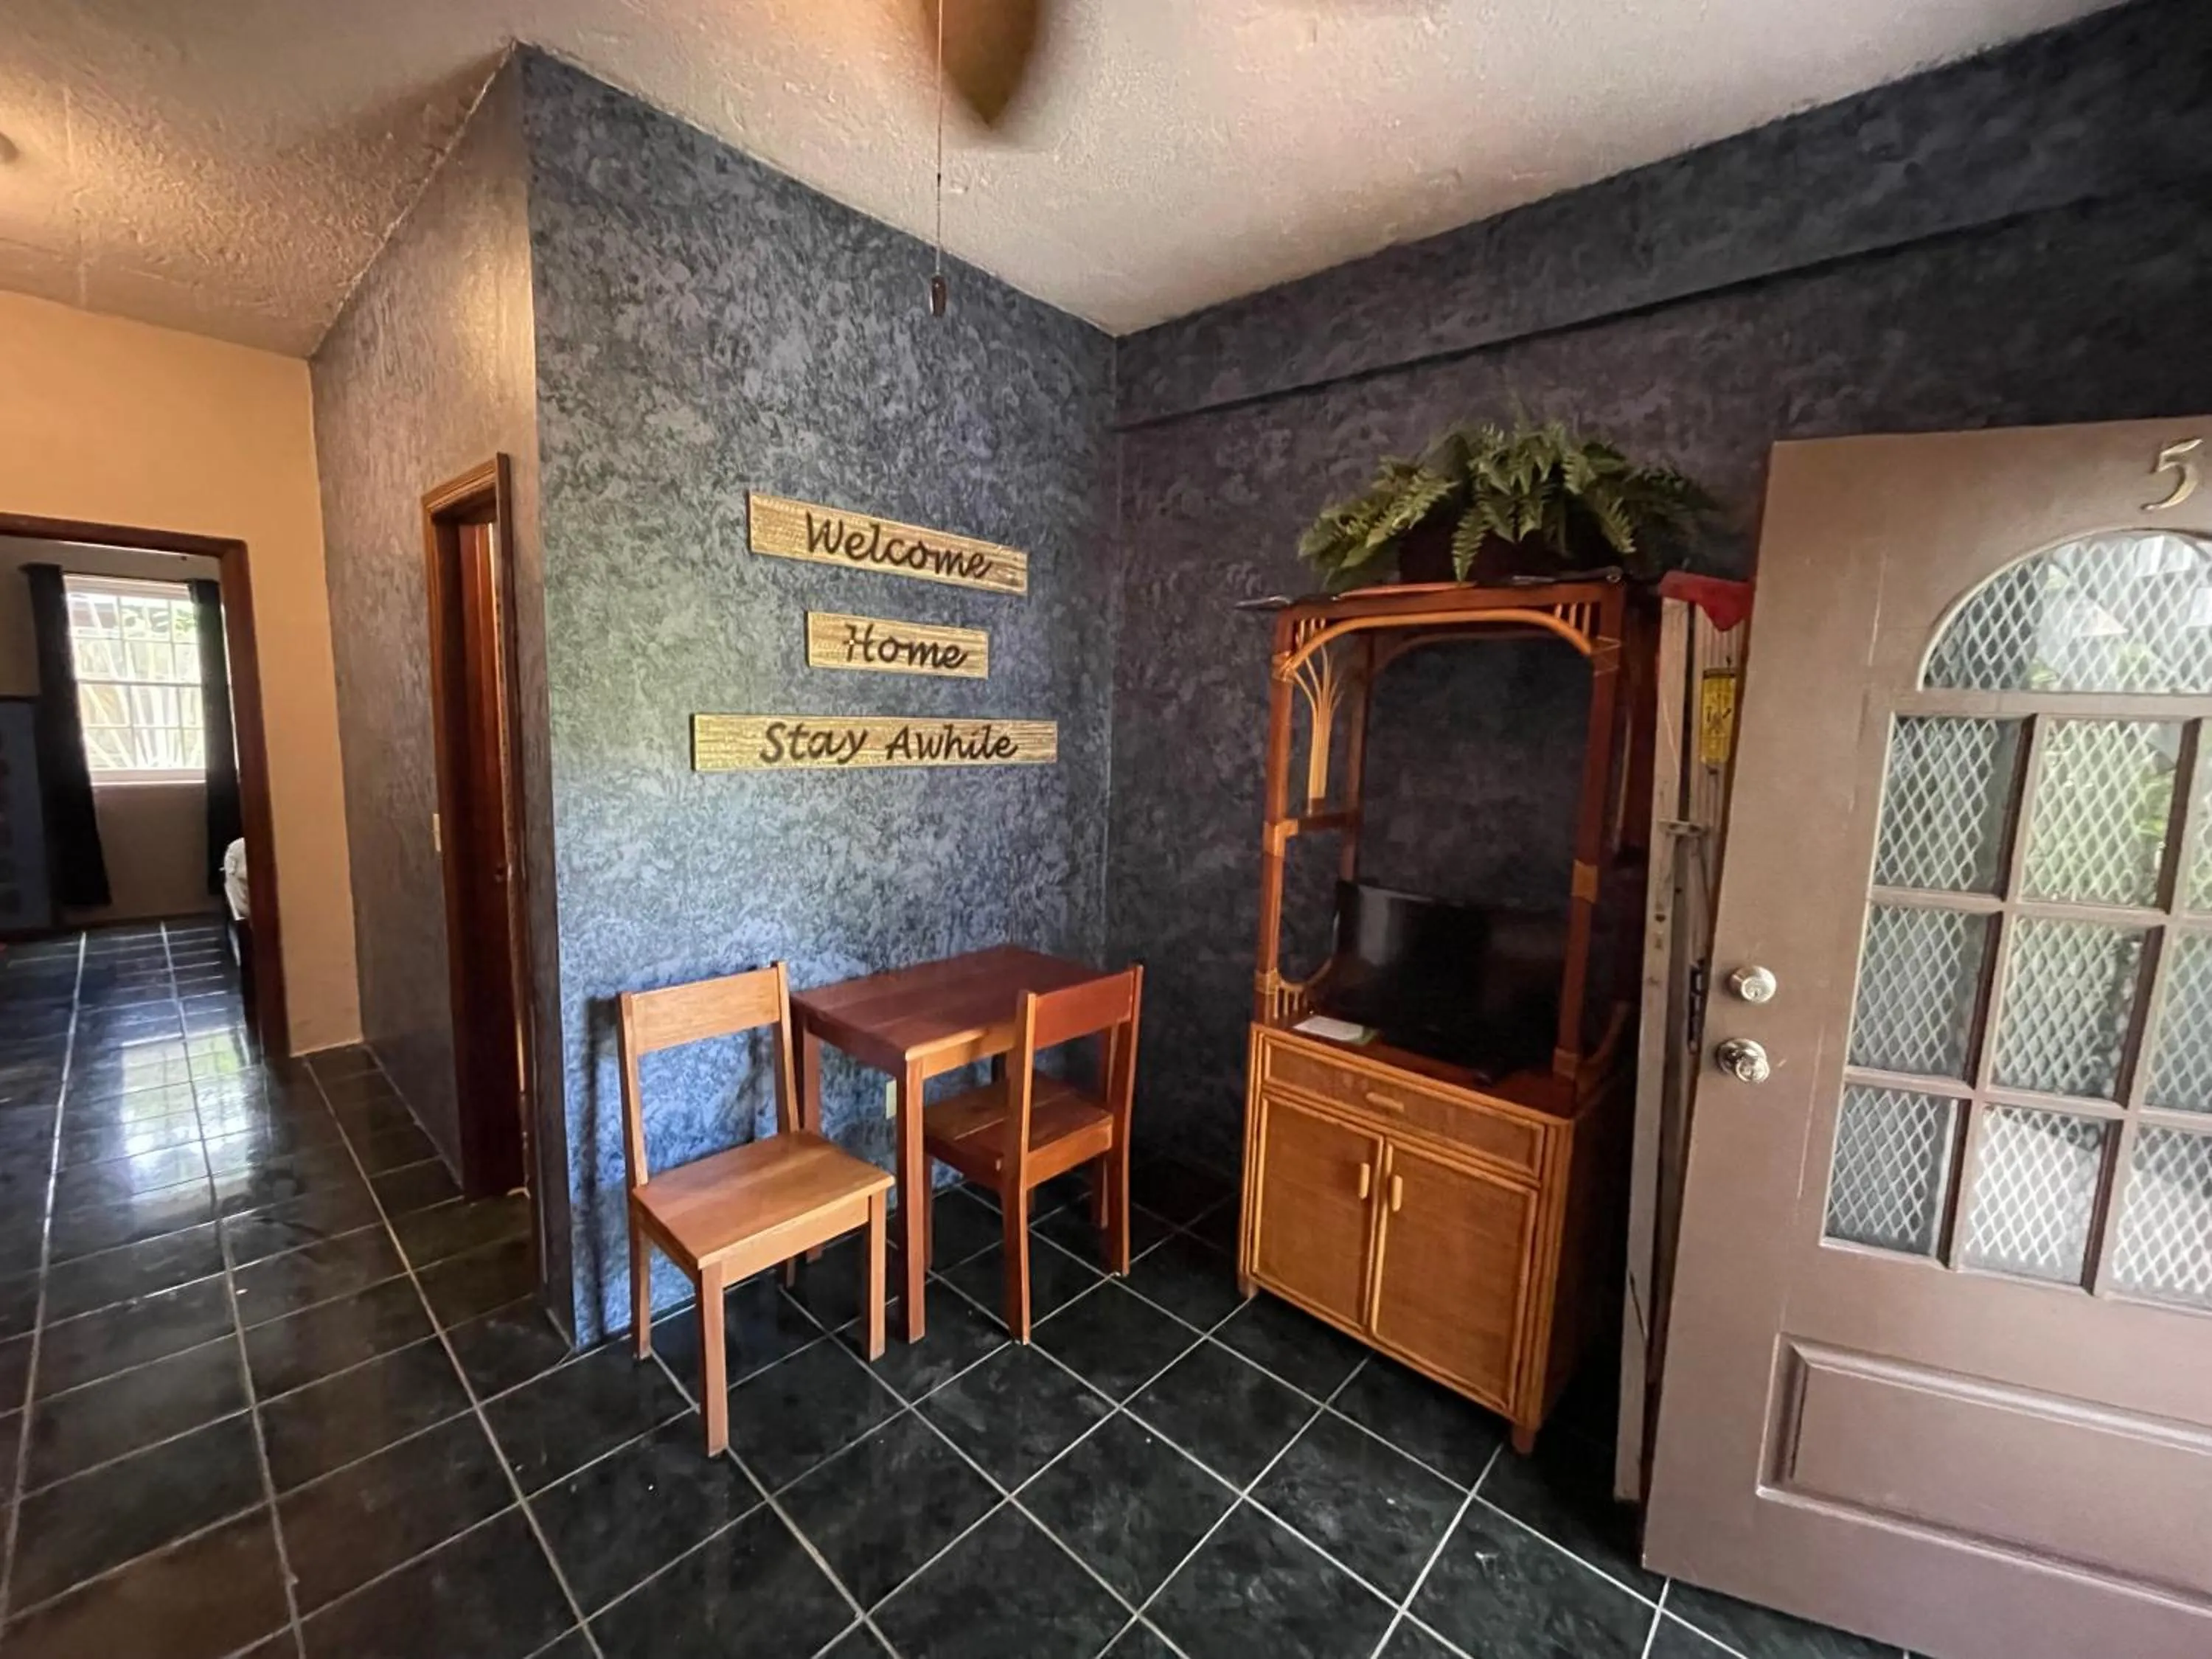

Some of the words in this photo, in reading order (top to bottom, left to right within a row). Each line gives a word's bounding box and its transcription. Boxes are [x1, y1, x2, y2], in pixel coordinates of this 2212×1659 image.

[2145, 438, 2203, 510] 5
[806, 511, 992, 580] Welcome
[844, 624, 968, 669] Home
[759, 722, 868, 764] Stay
[885, 724, 1019, 759] Awhile
